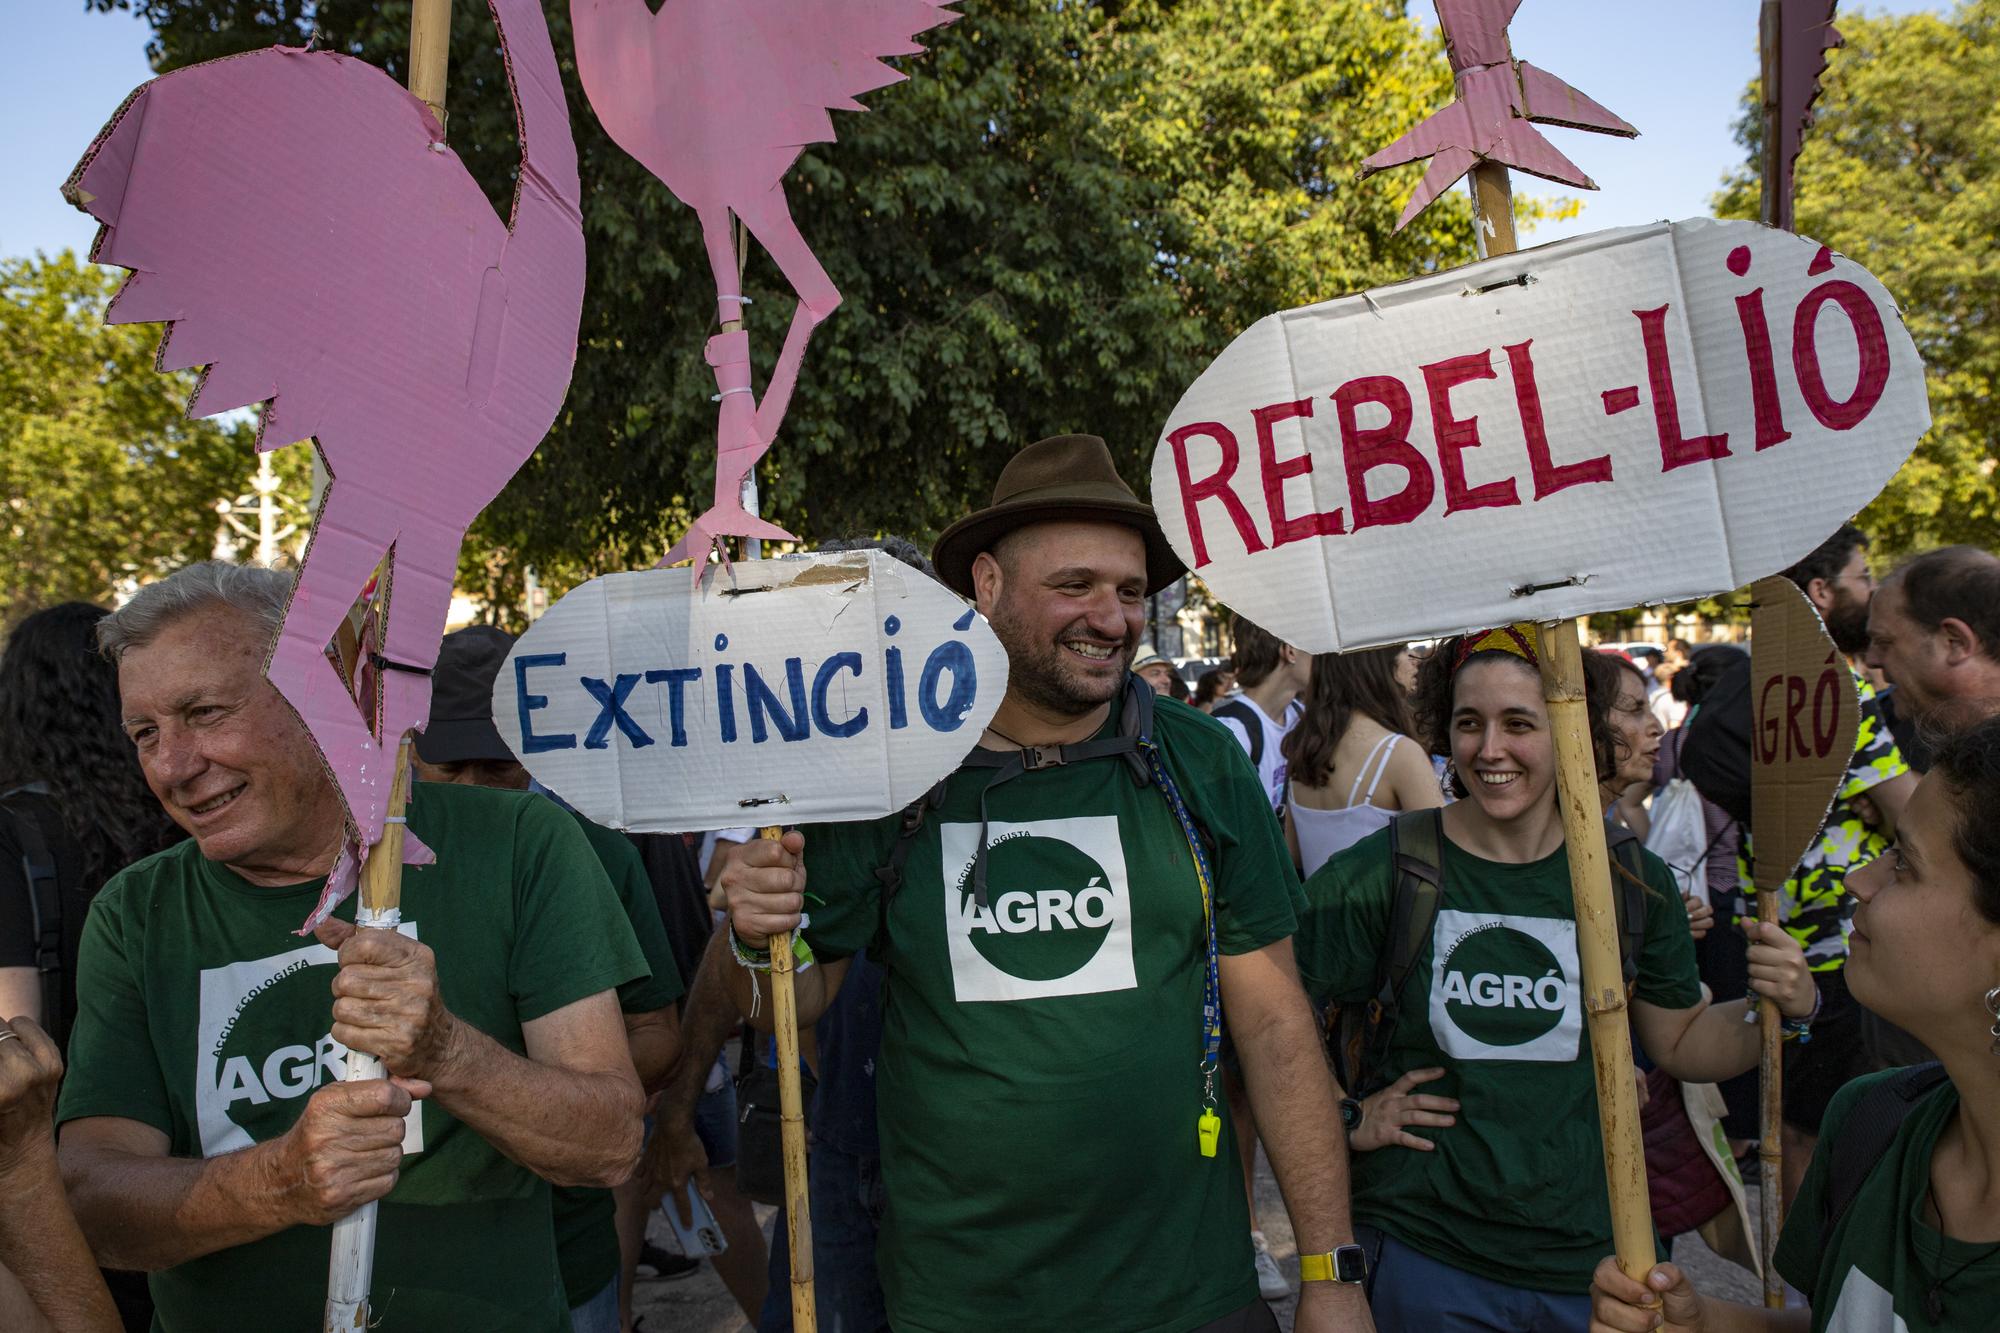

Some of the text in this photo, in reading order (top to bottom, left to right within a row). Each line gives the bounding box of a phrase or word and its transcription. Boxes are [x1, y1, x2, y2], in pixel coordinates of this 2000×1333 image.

[513, 608, 978, 755] EXTINCIÓ
[971, 830, 1031, 860] ELOGISTA
[962, 876, 1114, 935] AGRÓ
[234, 958, 310, 1016] ECOLOGISTA
[1443, 968, 1568, 1012] AGRÓ
[216, 1032, 349, 1107] AGR
